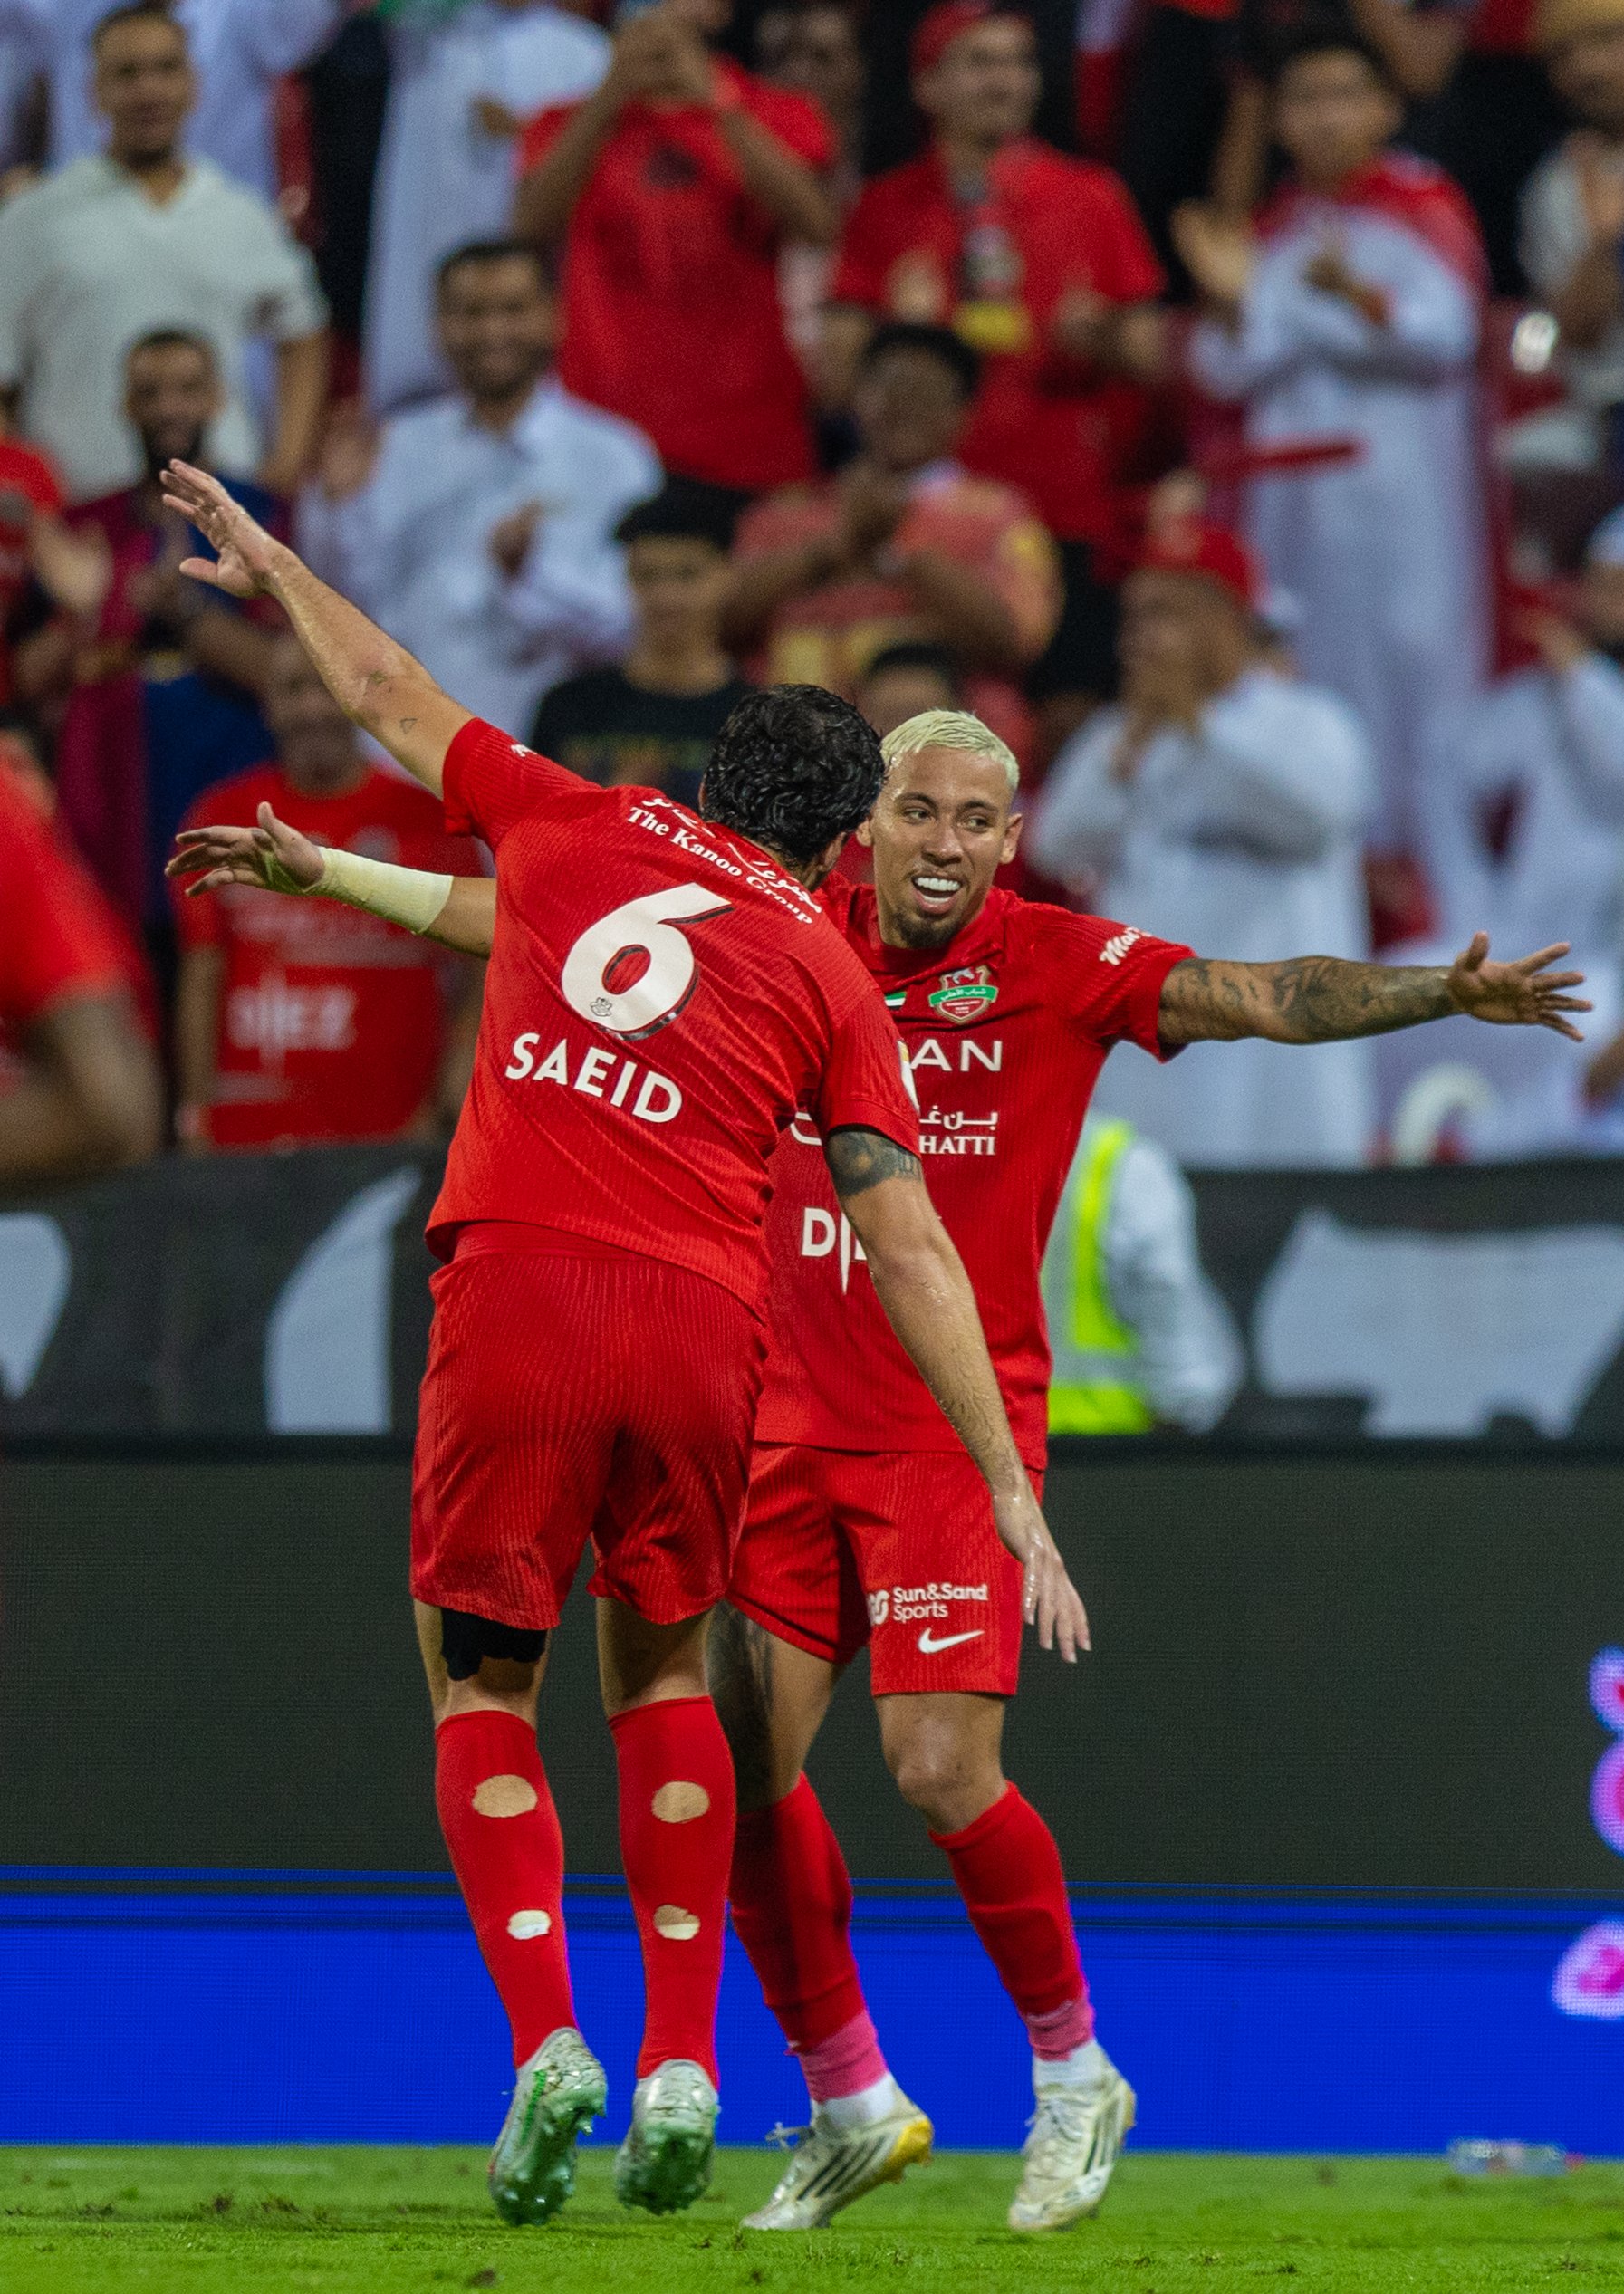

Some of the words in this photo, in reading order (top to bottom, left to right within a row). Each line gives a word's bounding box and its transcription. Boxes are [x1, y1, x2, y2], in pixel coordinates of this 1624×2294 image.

[627, 806, 670, 836] The
[669, 827, 743, 877] Kanoo
[745, 875, 813, 924] Group
[561, 881, 735, 1041] 6
[910, 1038, 1003, 1072] AN
[504, 1032, 683, 1124] SAEID
[918, 1135, 996, 1156] HATTI
[892, 1582, 989, 1604] Sun&Sand
[892, 1601, 949, 1624] Sports
